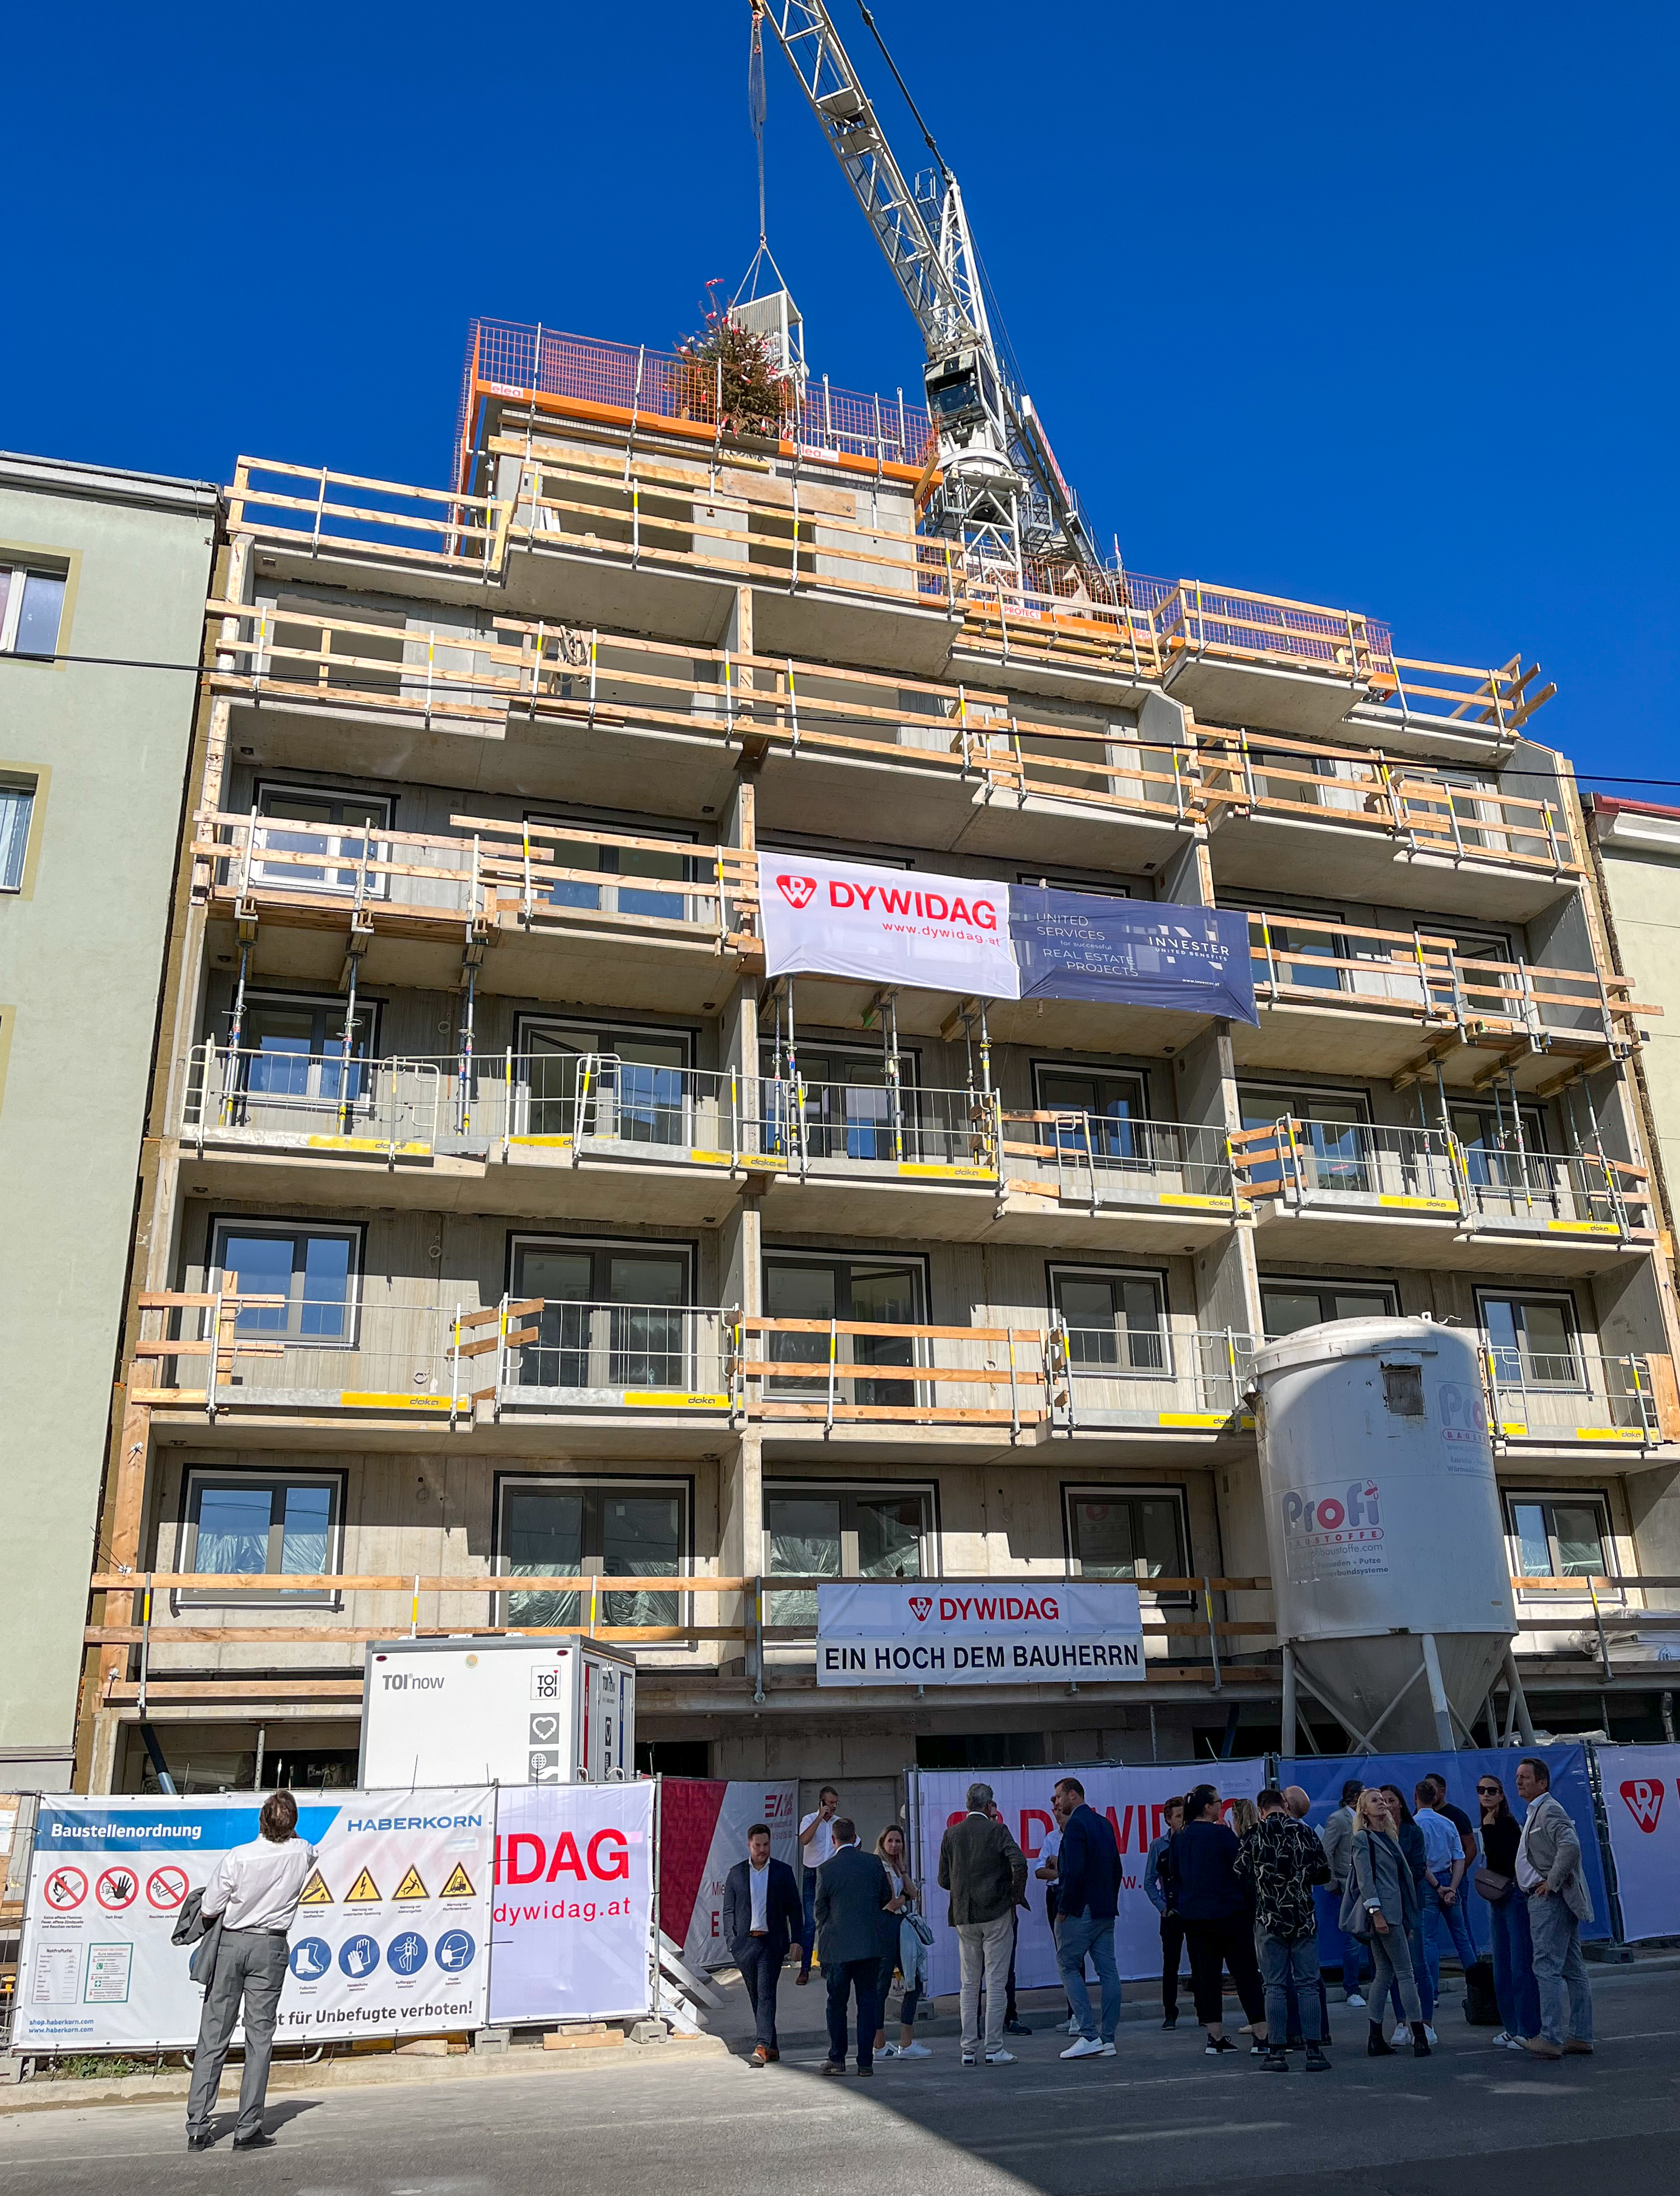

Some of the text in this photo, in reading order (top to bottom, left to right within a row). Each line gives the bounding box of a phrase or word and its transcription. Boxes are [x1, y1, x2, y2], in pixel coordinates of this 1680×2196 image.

[492, 385, 520, 396] elea
[1004, 606, 1040, 618] PROTECT
[829, 880, 997, 930] DYWIDAG
[1036, 913, 1088, 926] UNITED
[882, 922, 1000, 947] www.dywidag.at
[1037, 926, 1105, 941] SERVICES
[1149, 936, 1230, 956] INVESTER
[1043, 948, 1135, 965] REAL ESTATE
[1189, 951, 1227, 961] BENEFITS
[1067, 961, 1138, 976] PROJECTS
[409, 1397, 439, 1406] doka
[1318, 1560, 1351, 1569] Fassaden
[940, 1597, 1059, 1621] DYWIDAG
[825, 1644, 1138, 1669] EIN HOCH DEM BAUHERRN
[537, 1674, 557, 1685] TOI
[537, 1686, 557, 1697] TOI
[347, 1814, 482, 1832] HABERKORN
[51, 1823, 202, 1841] Baustellenordnung
[288, 2012, 311, 2025] für
[316, 2007, 397, 2023] Unbefugte
[400, 2000, 472, 2018] verboten!
